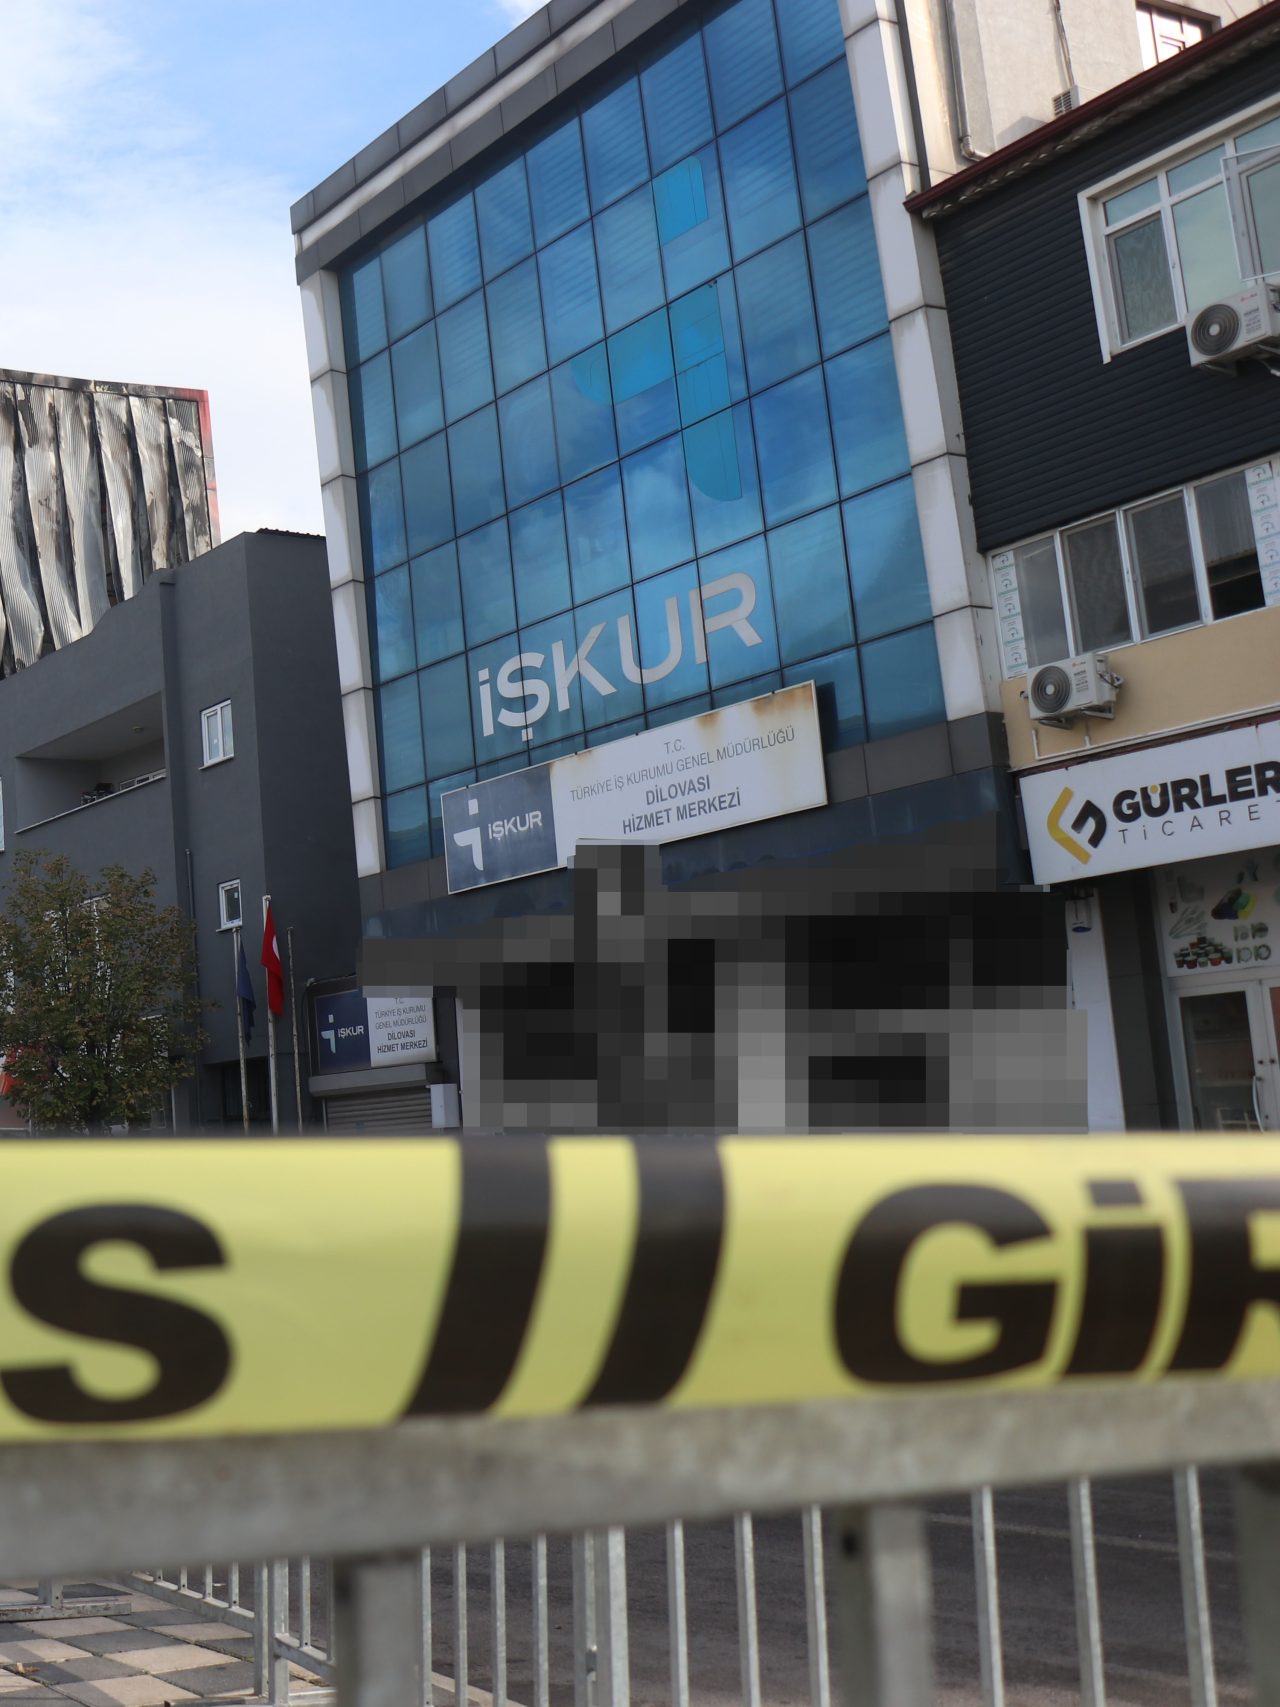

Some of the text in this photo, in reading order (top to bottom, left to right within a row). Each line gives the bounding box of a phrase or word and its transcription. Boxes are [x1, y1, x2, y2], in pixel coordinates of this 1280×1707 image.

[570, 779, 613, 801] TÜRKİYE
[626, 761, 674, 785] KURUMU
[676, 751, 715, 771] GENEL
[716, 725, 796, 762] MÜDÜRLÜĞÜ
[664, 739, 685, 755] T.C.
[645, 774, 711, 805] DİLOVASI
[622, 786, 741, 835] HİZMET MERKEZİ
[1118, 800, 1280, 844] TİCARE
[387, 1029, 416, 1041] DİLOVASI
